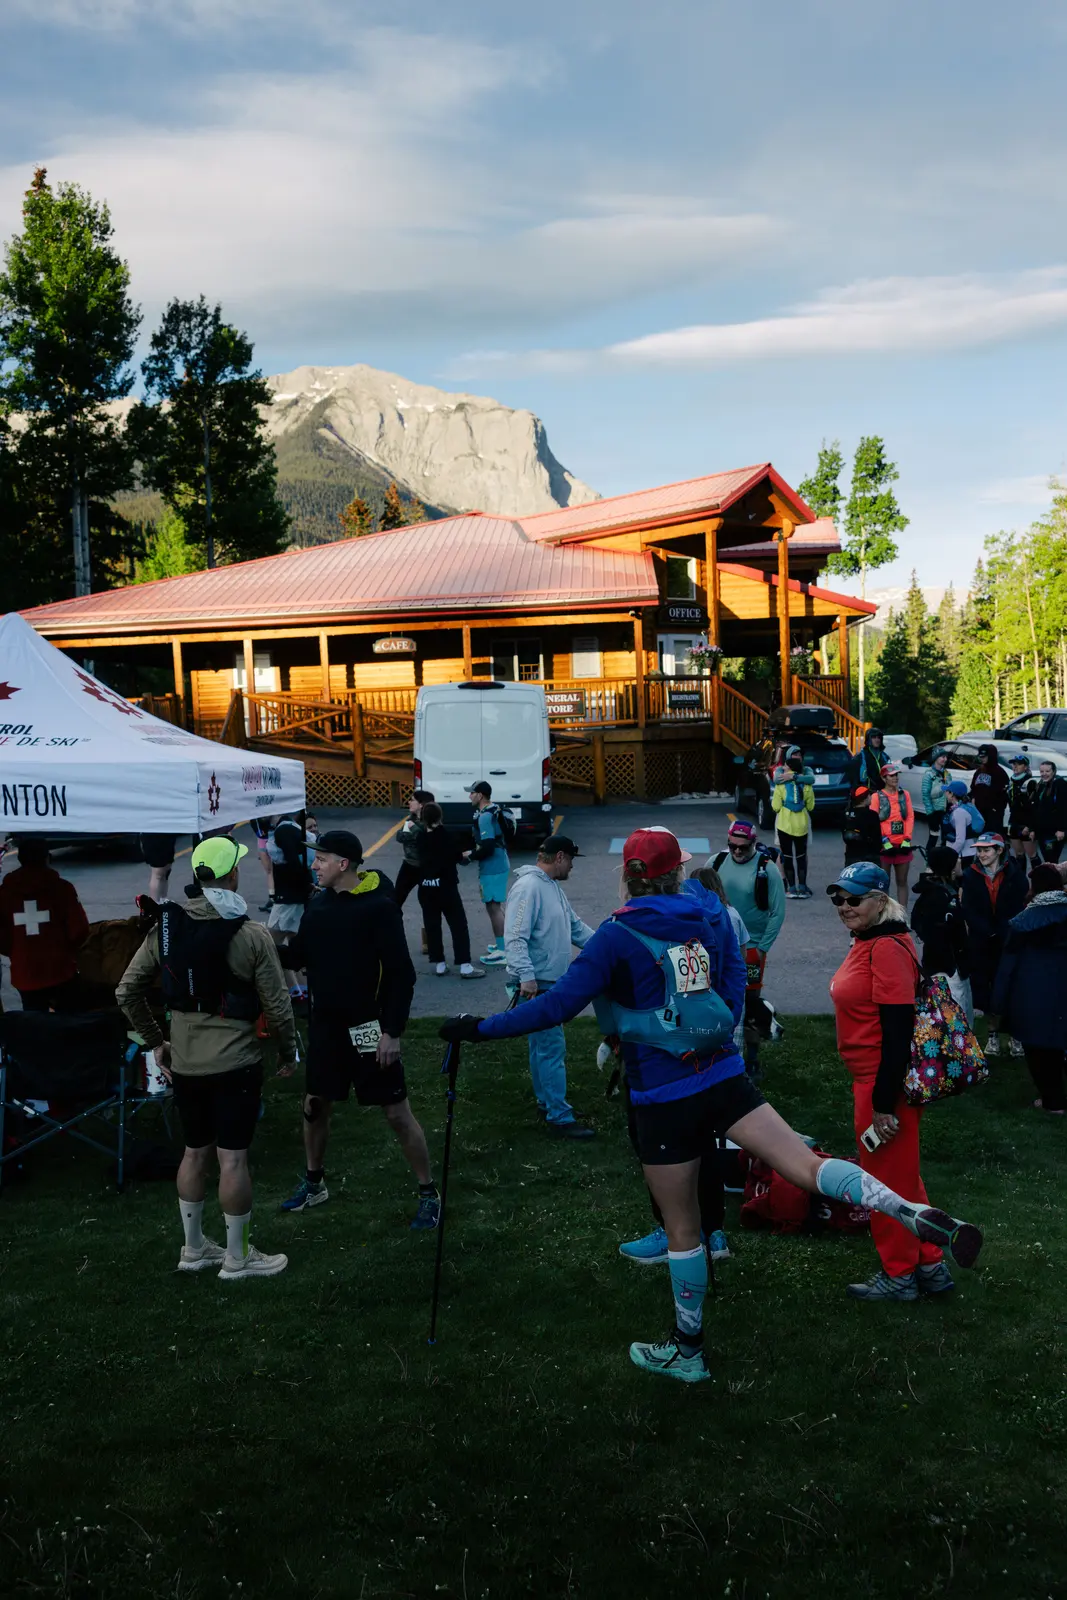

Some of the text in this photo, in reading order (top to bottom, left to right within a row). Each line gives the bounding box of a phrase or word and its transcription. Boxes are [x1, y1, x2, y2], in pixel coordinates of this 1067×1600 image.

[669, 607, 701, 618] OFFICE
[381, 640, 409, 650] CAFE
[16, 737, 45, 746] DE
[45, 737, 79, 746] SKI
[2, 784, 67, 816] NTON
[162, 911, 170, 956] SALOMON
[678, 954, 709, 976] 605
[355, 1029, 380, 1047] 653
